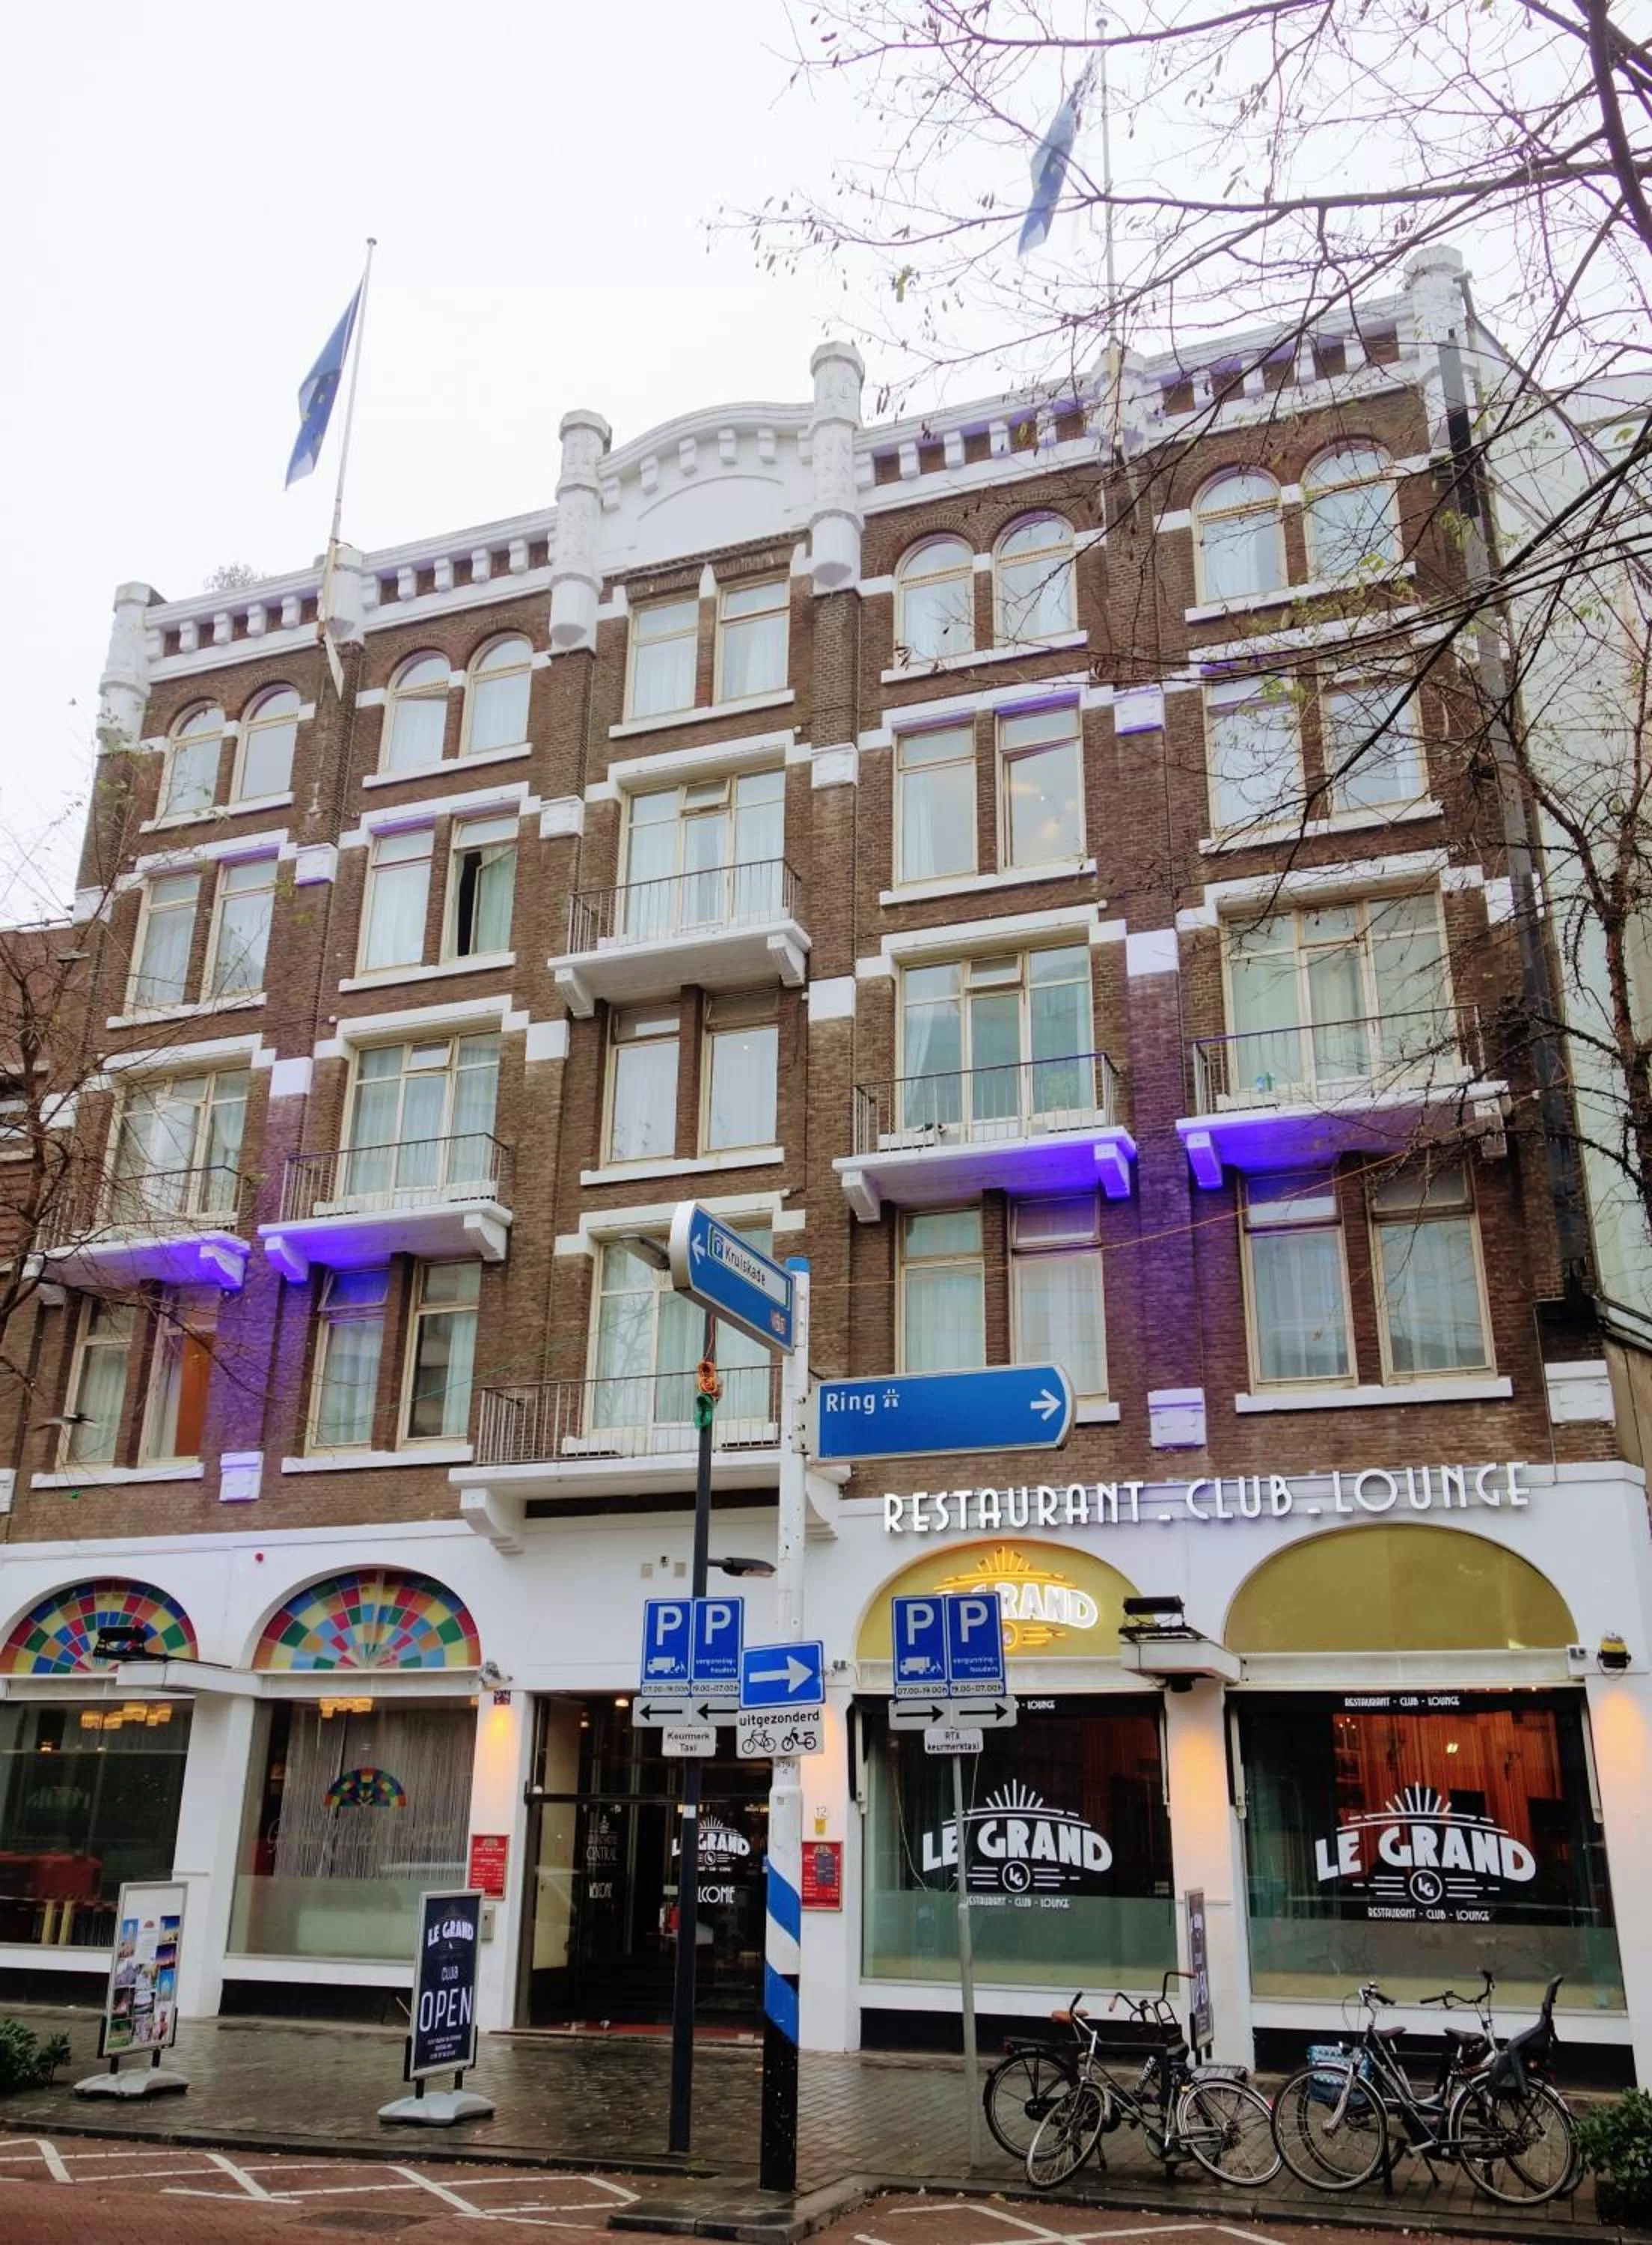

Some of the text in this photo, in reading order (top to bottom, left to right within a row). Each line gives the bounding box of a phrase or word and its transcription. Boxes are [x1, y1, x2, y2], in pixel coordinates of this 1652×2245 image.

[725, 1245, 765, 1286] Kruiskade
[826, 1392, 875, 1414] Ring
[884, 1482, 1144, 1533] RESTAURANT
[1185, 1474, 1293, 1520] CLUB
[1332, 1461, 1532, 1512] LOUNGE
[656, 1605, 683, 1646] P
[706, 1604, 732, 1644] P
[905, 1604, 935, 1645] P
[959, 1600, 988, 1643] P
[970, 1582, 1099, 1629] RAND
[739, 1709, 820, 1727] uitgezonderd
[1344, 1696, 1391, 1707] RESTAURANT
[1399, 1696, 1419, 1706] CLUB
[1428, 1695, 1460, 1706] LOUNGE
[667, 1732, 710, 1741] Keurmerk
[679, 1743, 697, 1752] Taxi
[698, 1832, 750, 1856] GRAND
[923, 1819, 1113, 1872] LE GRAND
[1315, 1826, 1536, 1882] LE GRAND
[697, 1886, 735, 1904] LCOME
[1368, 1908, 1416, 1919] RESTAURANT
[1426, 1910, 1446, 1919] CLUB
[1457, 1910, 1490, 1921] LOUNGE
[428, 1919, 474, 1946] LE GRAND
[419, 1985, 474, 2032] OPEN
